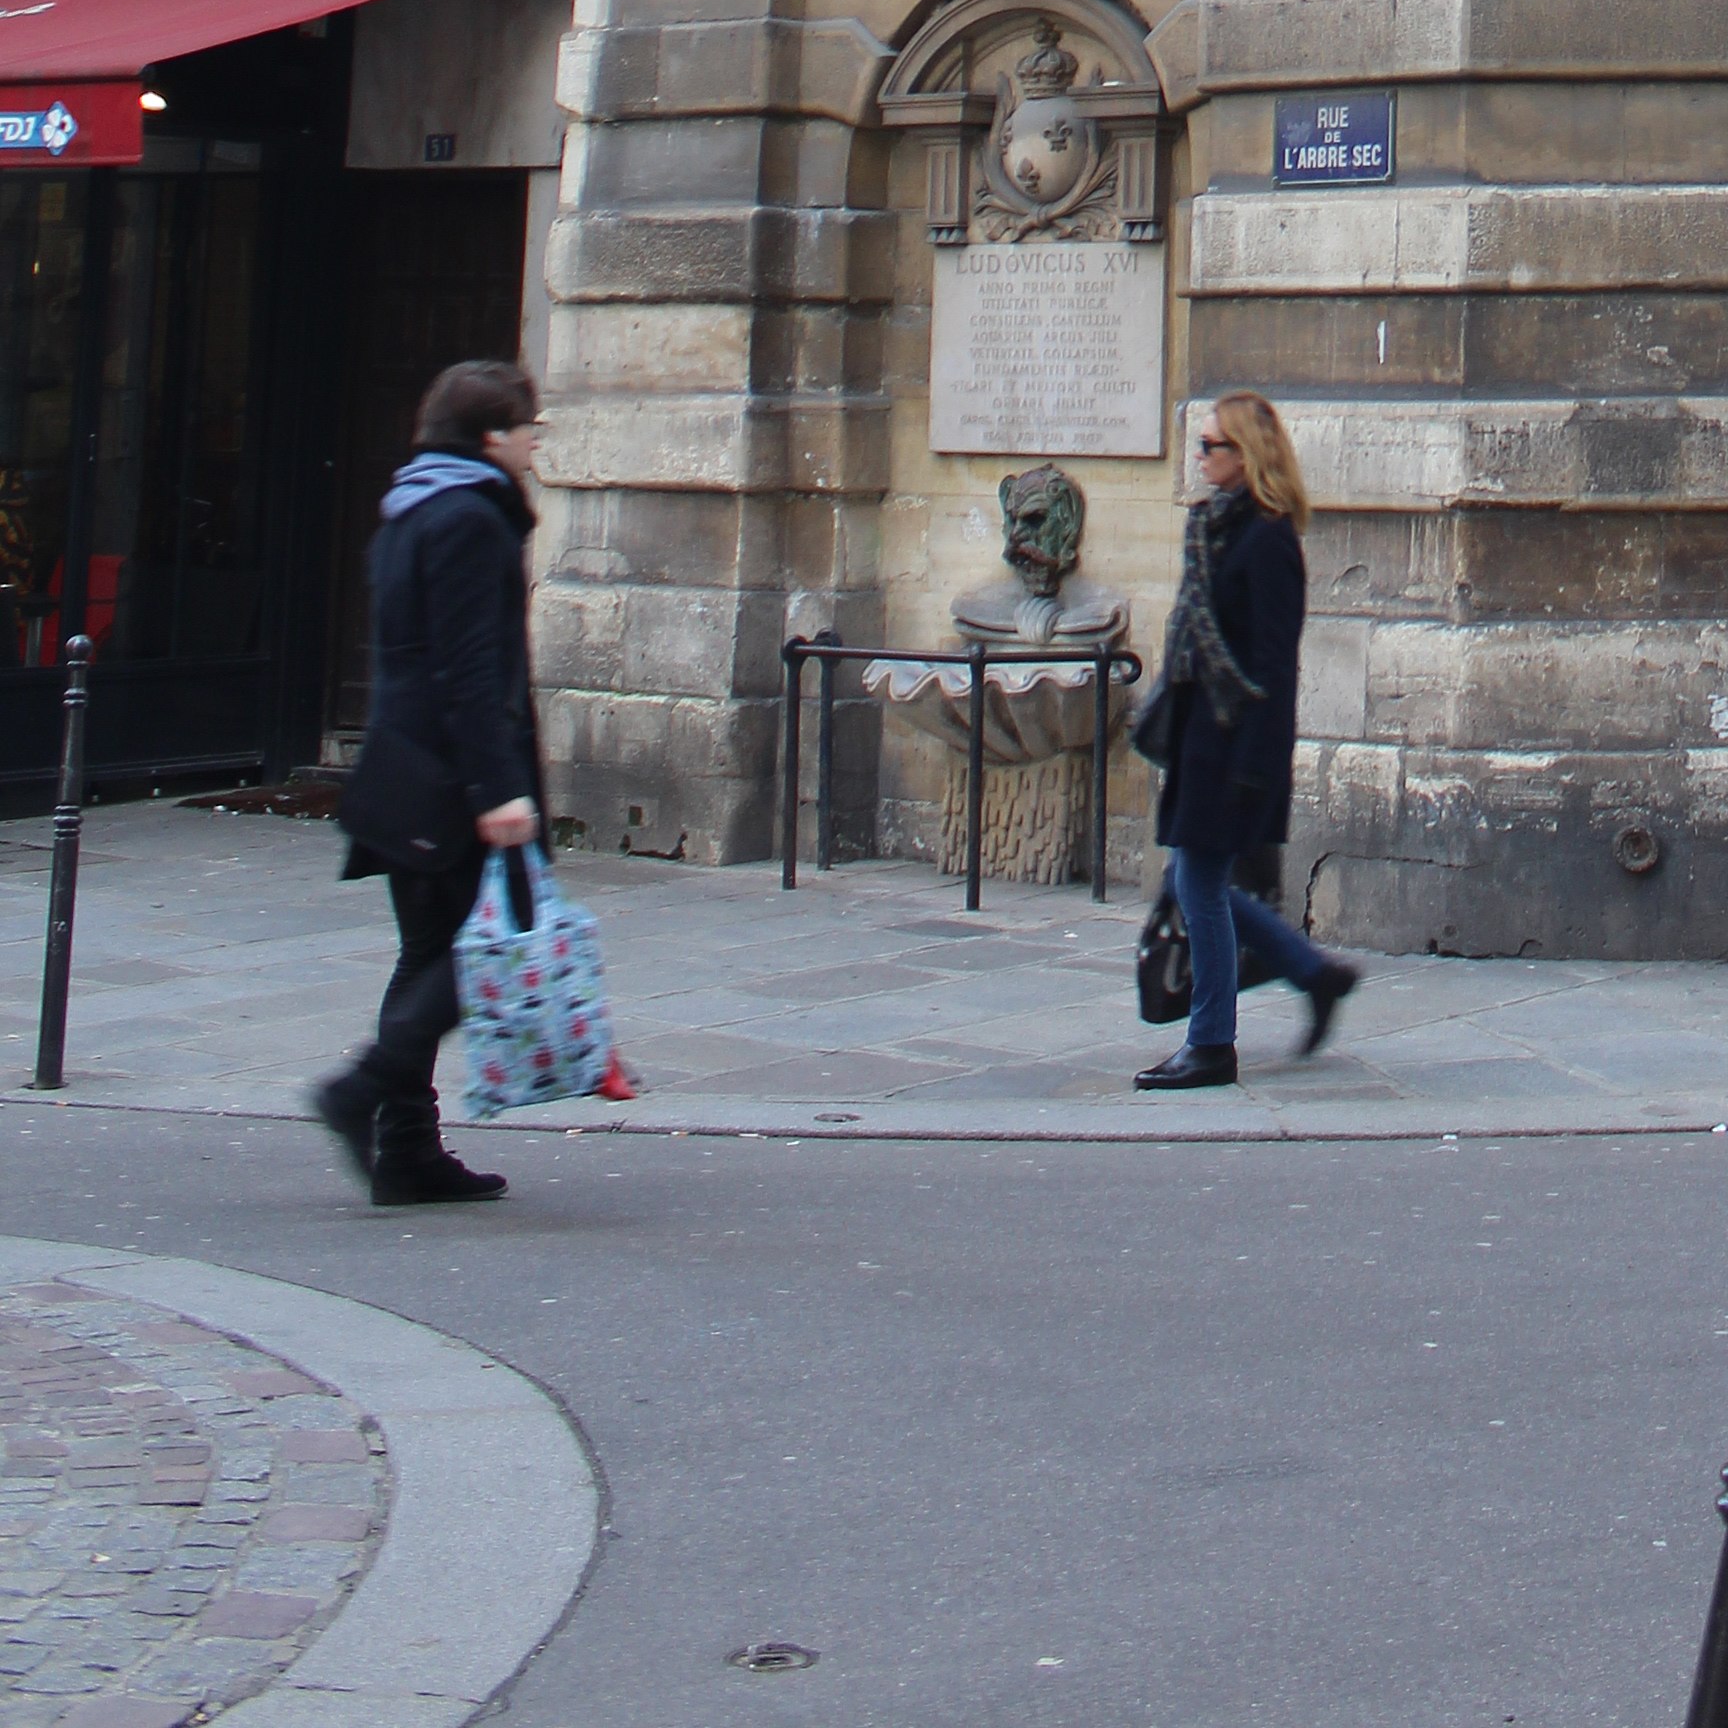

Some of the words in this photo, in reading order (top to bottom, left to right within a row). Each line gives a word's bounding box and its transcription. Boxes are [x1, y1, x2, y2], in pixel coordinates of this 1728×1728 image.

[1317, 107, 1349, 128] RUE
[1324, 131, 1341, 143] DE
[431, 138, 449, 158] 51
[1284, 145, 1347, 169] L'ARBRE
[1352, 144, 1382, 167] SEC
[956, 252, 1086, 275] LUDOVICUS
[1102, 251, 1139, 274] XVI
[978, 281, 1014, 294] ANNO
[1022, 281, 1066, 295] PRIMO
[1074, 280, 1115, 294] REGNI
